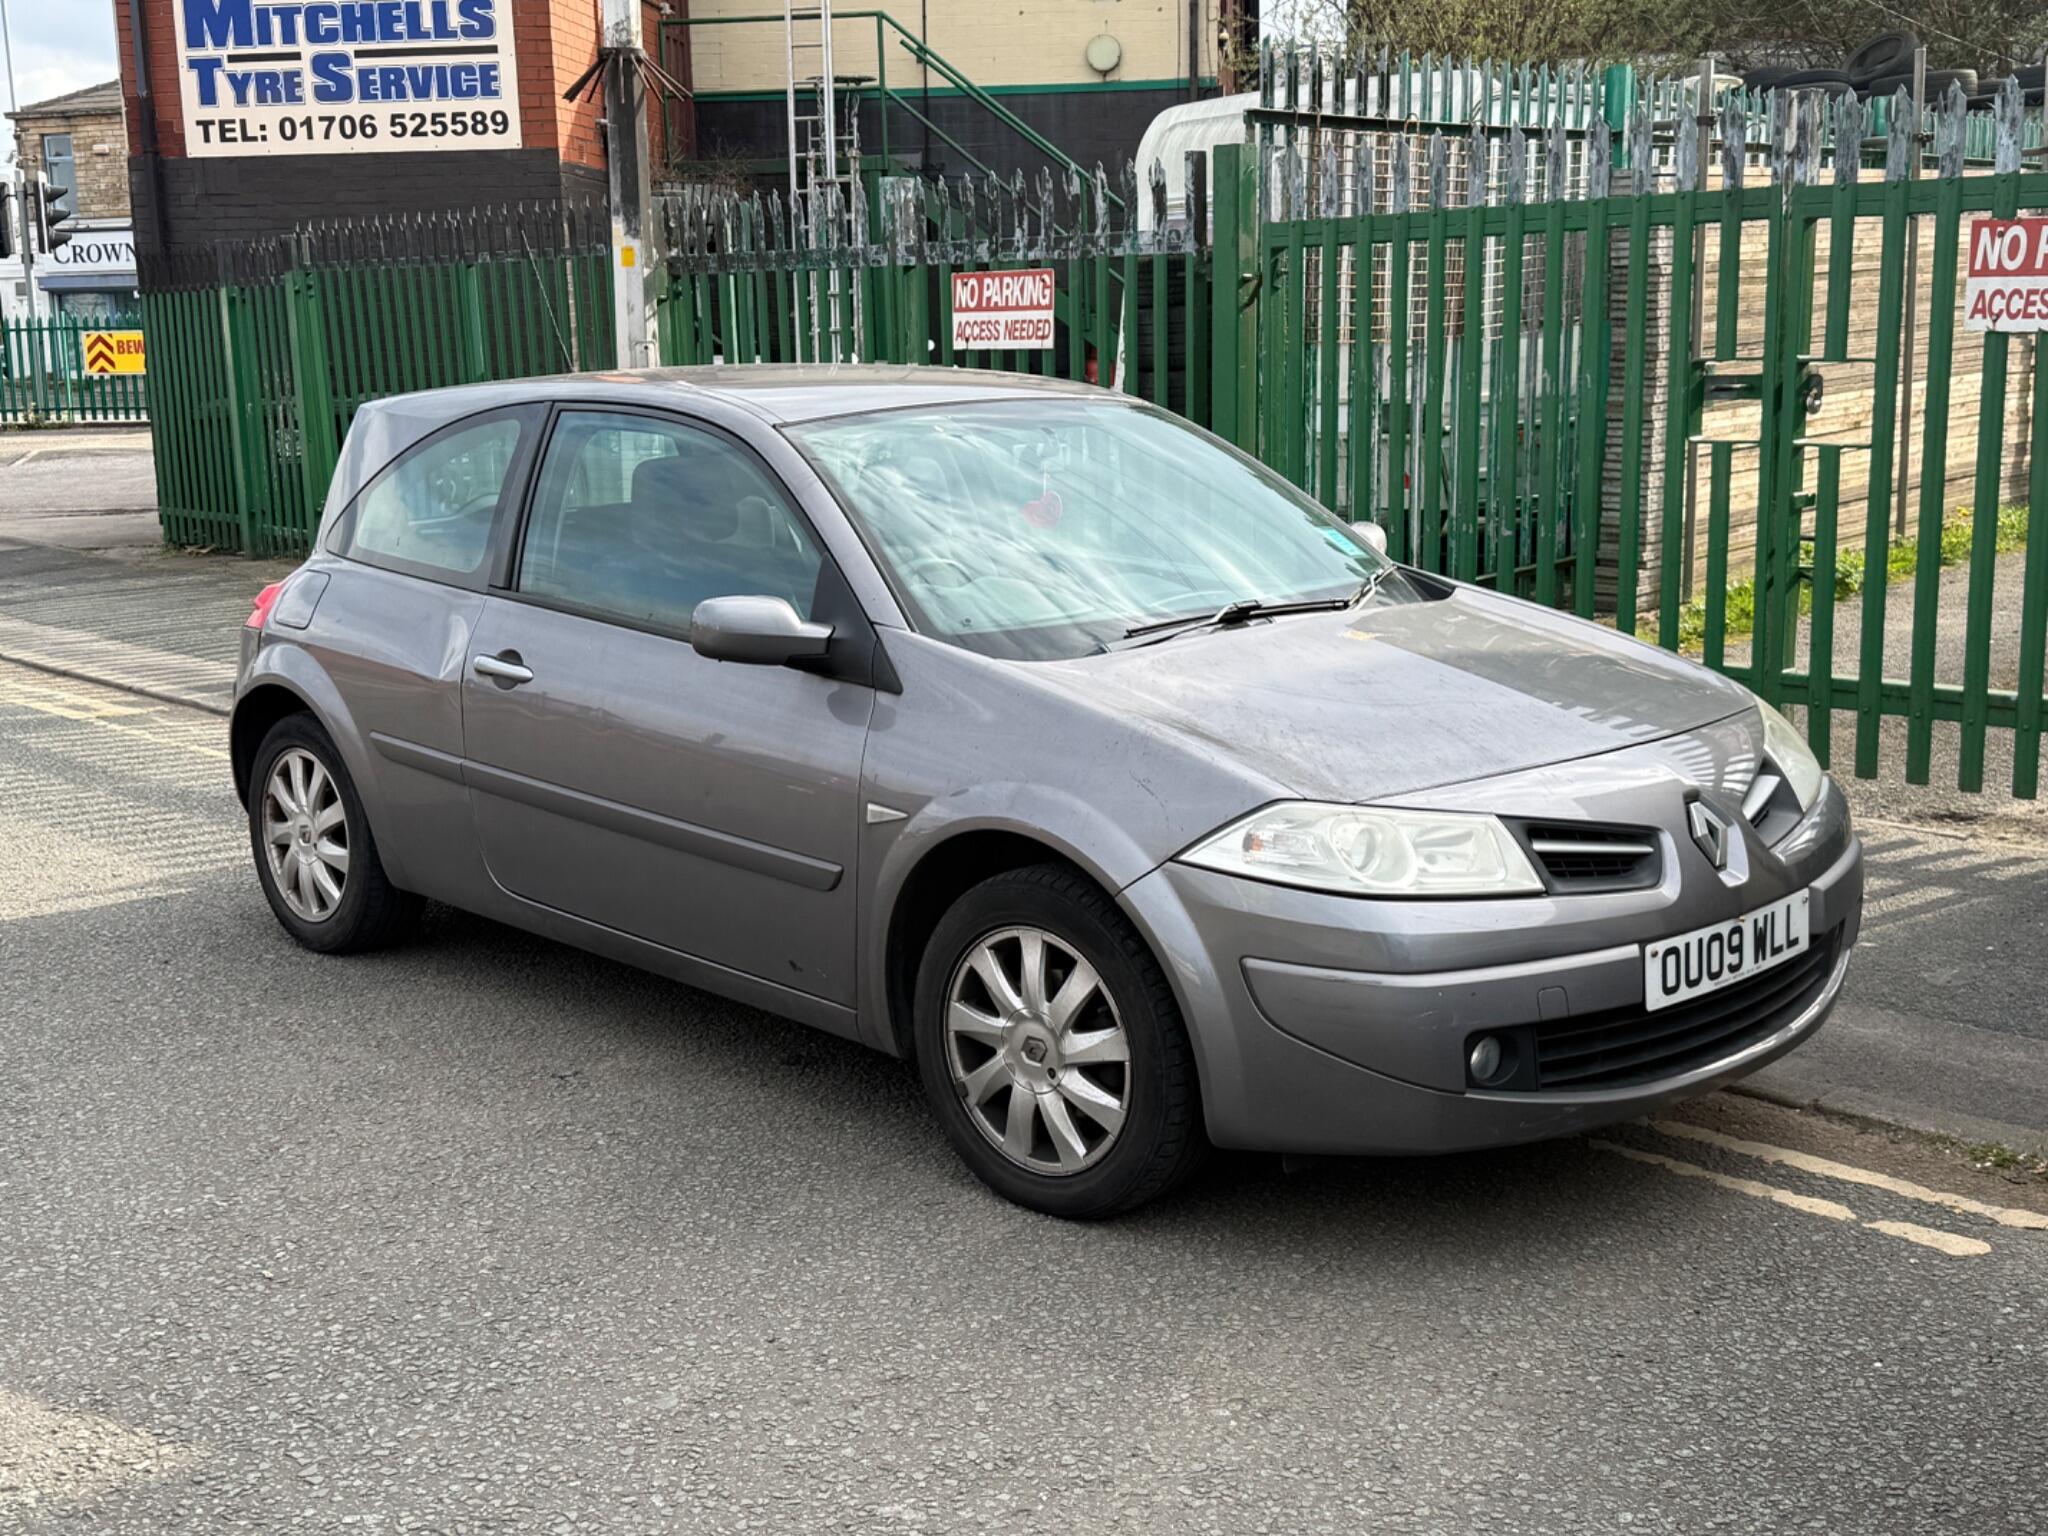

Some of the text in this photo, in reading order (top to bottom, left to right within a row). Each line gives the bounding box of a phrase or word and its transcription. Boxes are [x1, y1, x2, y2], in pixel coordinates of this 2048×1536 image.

[184, 0, 497, 49] MITCHELLS
[187, 50, 502, 108] TYRE SERVICE
[196, 110, 509, 143] TEL: 01706 525589
[1974, 225, 2028, 271] NO
[955, 273, 1051, 308] NO PARKING
[956, 319, 1051, 341] ACCESS NEEDED
[1661, 904, 1799, 996] OU09 WLL
